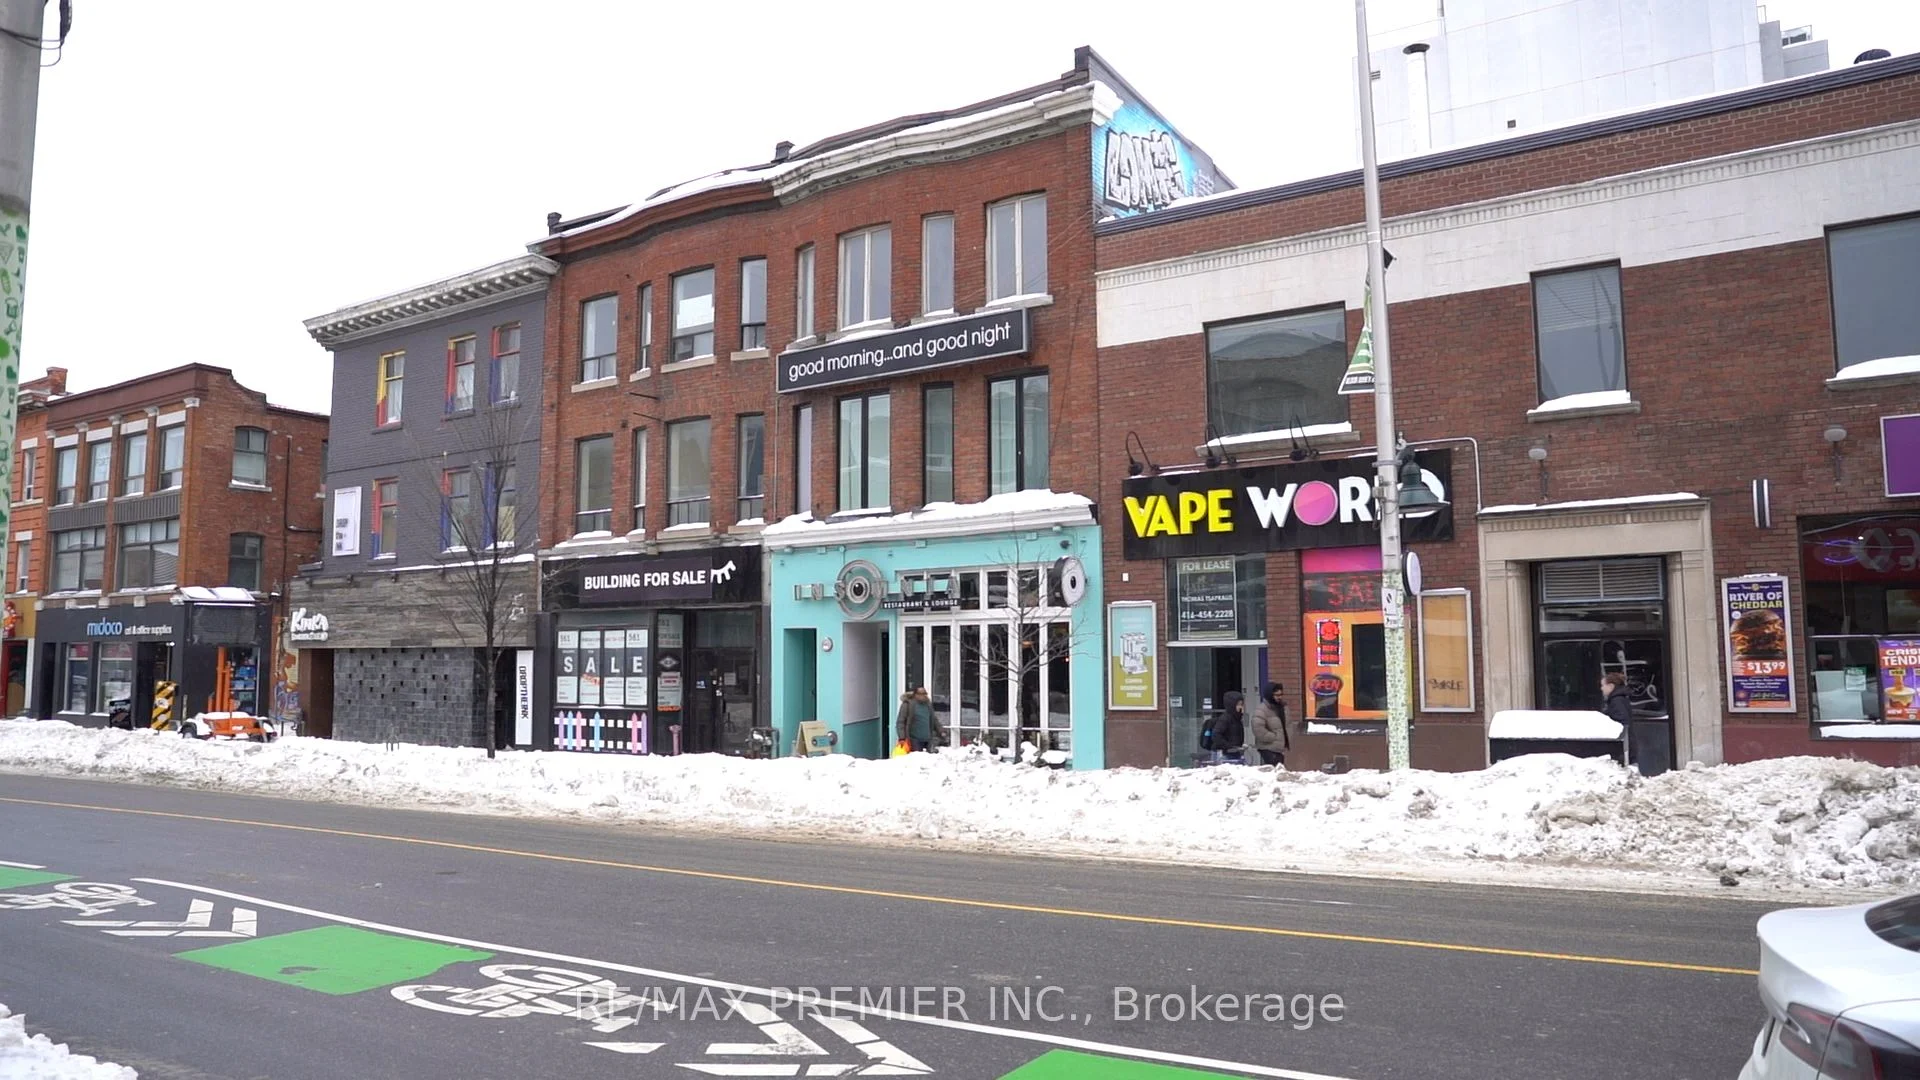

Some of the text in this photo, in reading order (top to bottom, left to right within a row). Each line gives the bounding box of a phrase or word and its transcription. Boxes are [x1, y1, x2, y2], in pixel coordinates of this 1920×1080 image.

[788, 357, 824, 381] good
[927, 330, 968, 357] good
[971, 321, 1011, 347] night
[1123, 488, 1234, 538] VAPE
[1182, 560, 1230, 571] FOR LEASE
[584, 570, 706, 590] BUILDING FOR SALE
[1729, 592, 1783, 601] RIVER OF
[884, 601, 923, 609] RESTAURANT
[1731, 600, 1783, 609] CHEDDAR
[1886, 648, 1920, 656] CRIS
